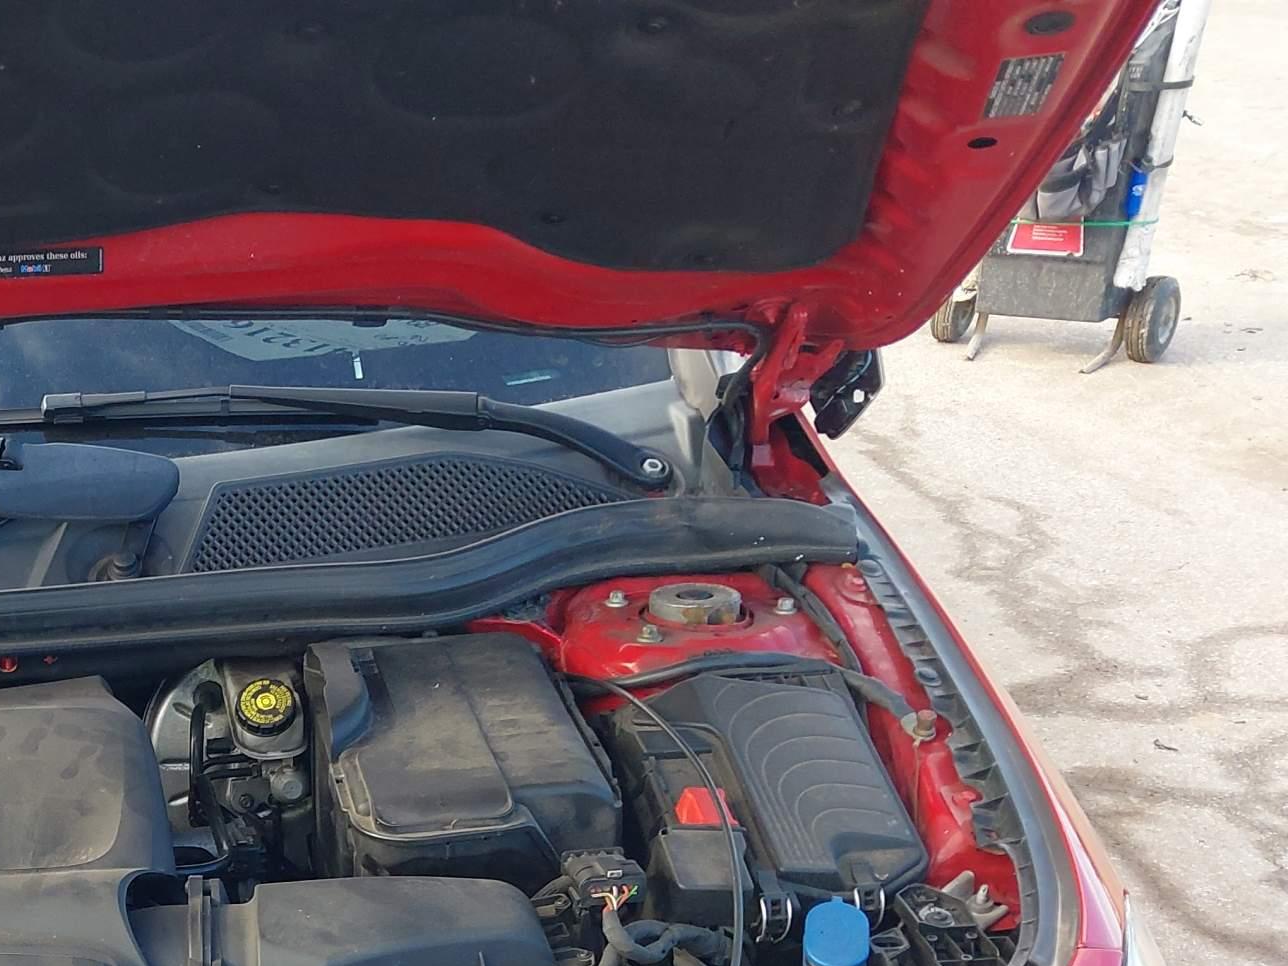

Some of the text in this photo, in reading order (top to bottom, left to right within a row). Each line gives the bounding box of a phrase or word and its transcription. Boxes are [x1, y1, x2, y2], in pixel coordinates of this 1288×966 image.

[8, 253, 45, 264] approves
[47, 251, 69, 261] these
[70, 250, 88, 260] oils:
